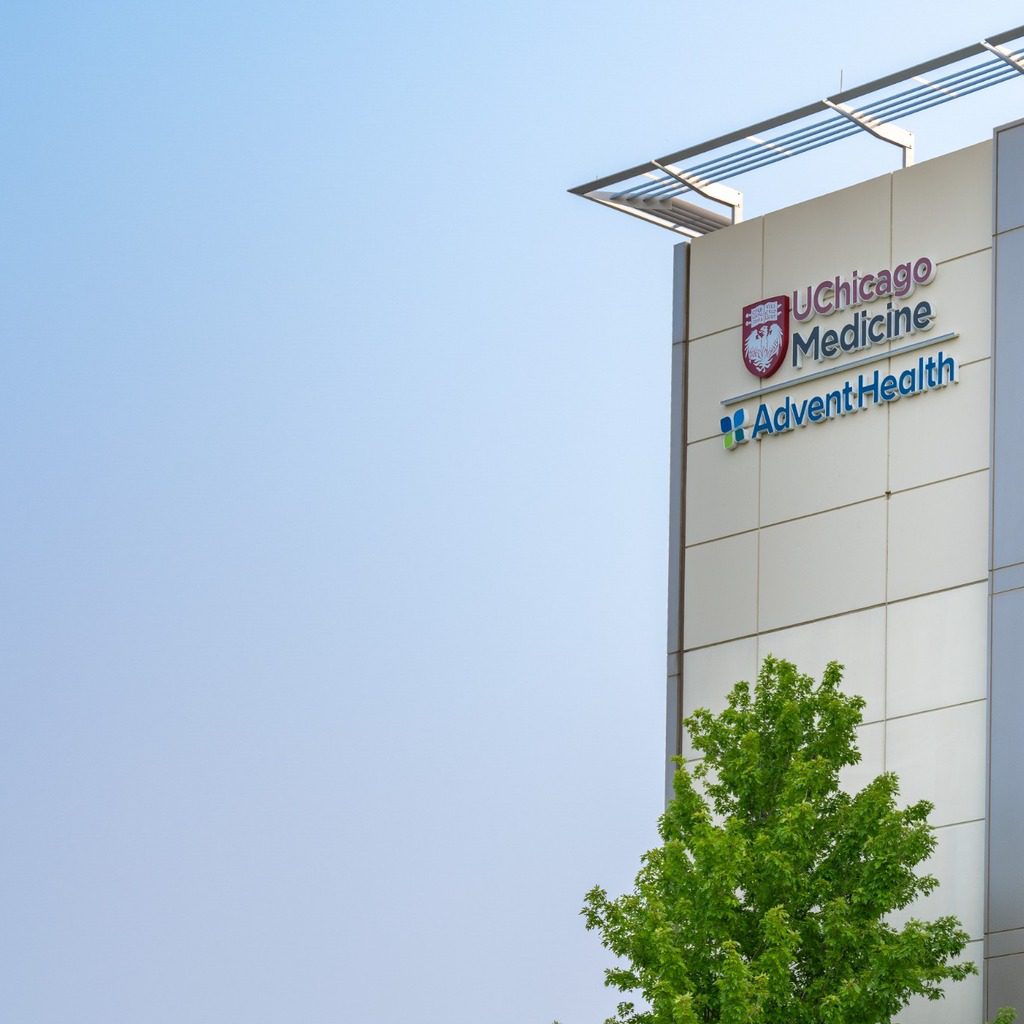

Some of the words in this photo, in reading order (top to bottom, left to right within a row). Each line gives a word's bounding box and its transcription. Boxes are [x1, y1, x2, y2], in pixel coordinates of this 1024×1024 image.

[792, 257, 935, 323] UChicago
[792, 300, 934, 368] Medicine
[751, 351, 958, 440] AdventHealth
